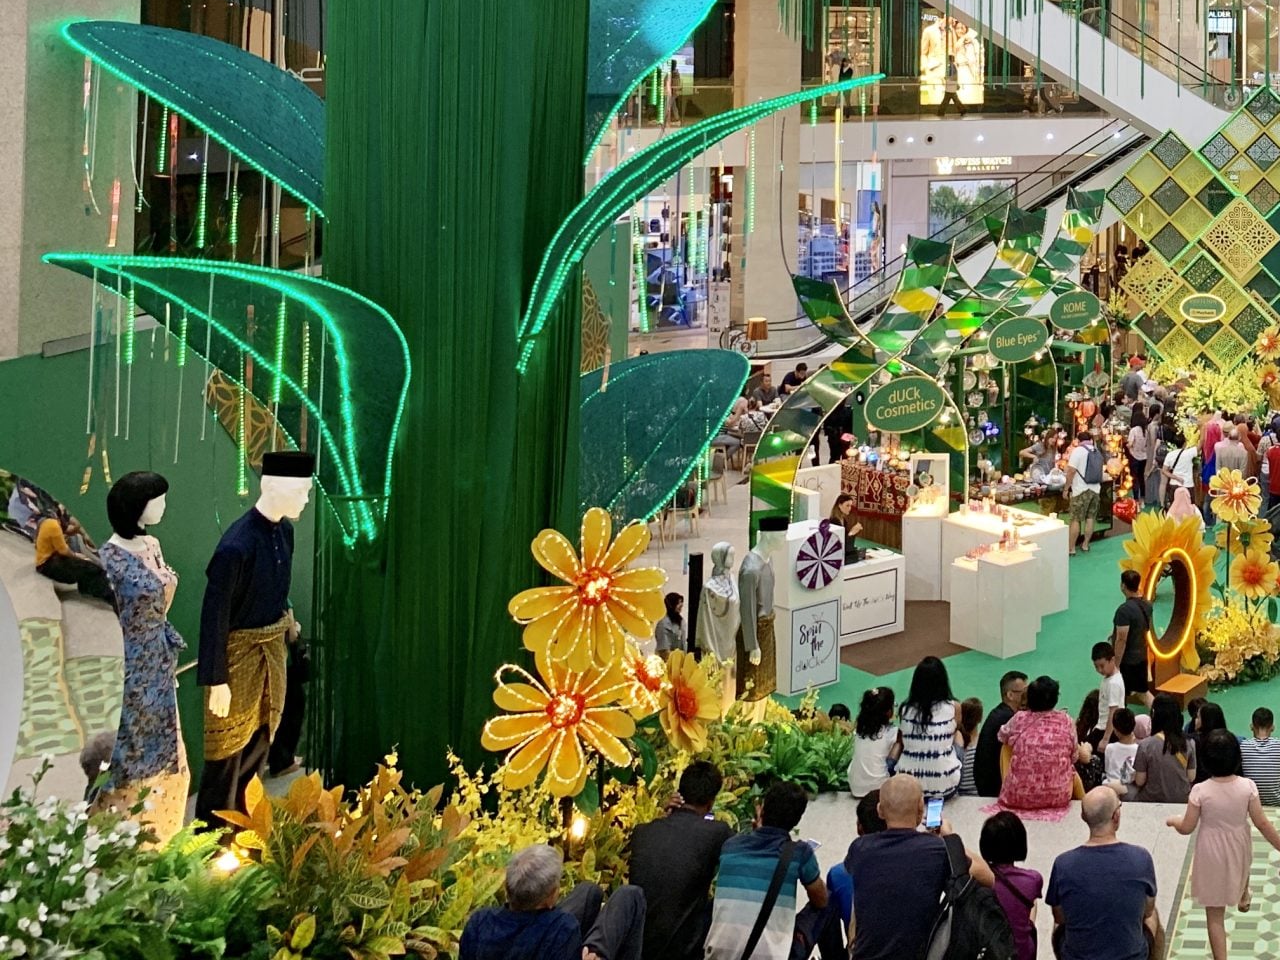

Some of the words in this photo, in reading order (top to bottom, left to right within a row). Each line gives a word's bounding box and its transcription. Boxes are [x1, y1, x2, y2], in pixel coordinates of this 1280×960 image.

[982, 156, 1013, 166] WATCH
[1063, 300, 1088, 314] KOME
[996, 336, 1016, 349] Blue
[1017, 333, 1038, 347] Eyes
[888, 386, 921, 405] dUCk
[876, 398, 936, 420] Cosmetics
[799, 623, 822, 646] Spin
